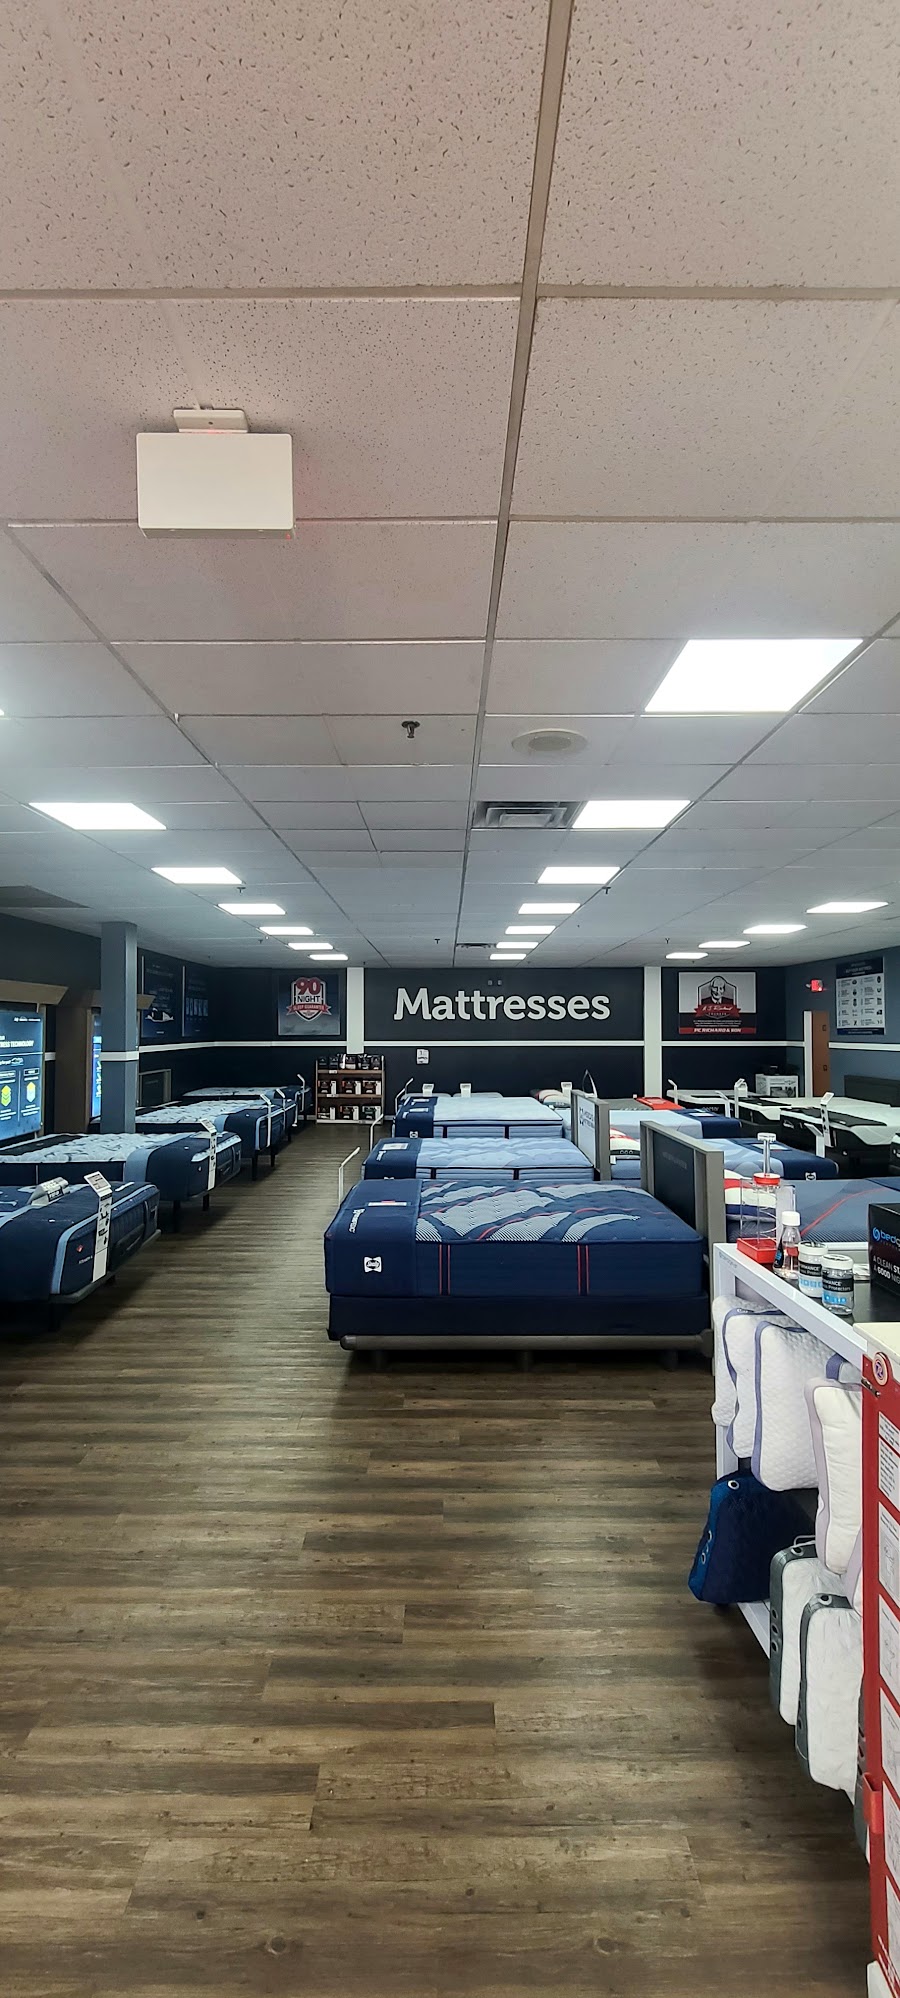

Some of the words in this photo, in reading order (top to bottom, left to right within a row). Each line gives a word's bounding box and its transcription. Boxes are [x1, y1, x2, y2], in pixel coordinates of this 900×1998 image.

[295, 978, 321, 995] 90
[297, 995, 321, 1003] NIGHT
[393, 987, 611, 1020] Mattresses
[872, 1254, 877, 1262] A
[876, 1258, 893, 1271] CLEAN
[877, 1266, 891, 1279] GOOD
